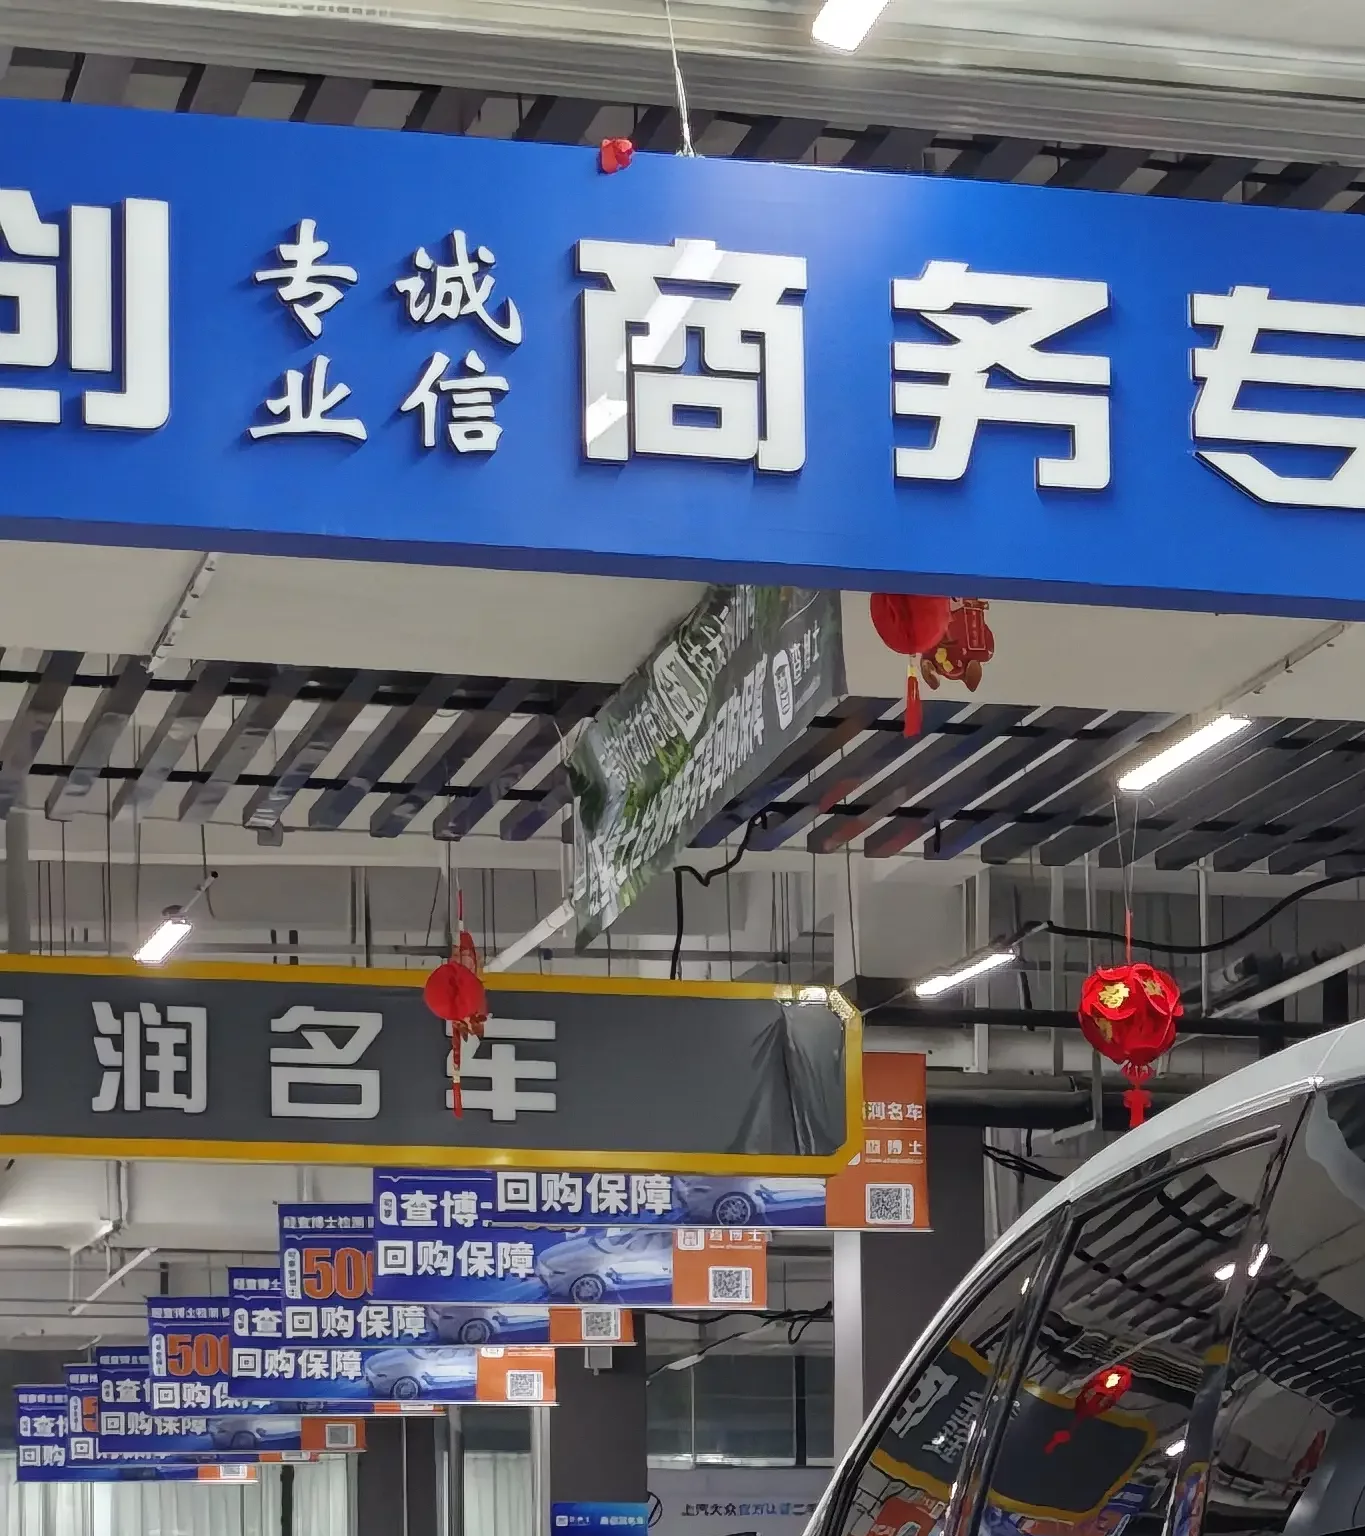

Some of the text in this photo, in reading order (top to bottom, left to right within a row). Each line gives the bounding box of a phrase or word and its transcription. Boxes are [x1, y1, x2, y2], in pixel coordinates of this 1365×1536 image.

[0, 998, 557, 1121] 润名车
[497, 1172, 673, 1215] 回购保障
[377, 1240, 535, 1279] 回购保障
[285, 1305, 427, 1338] 回购保障
[232, 1347, 362, 1380] 回购保障
